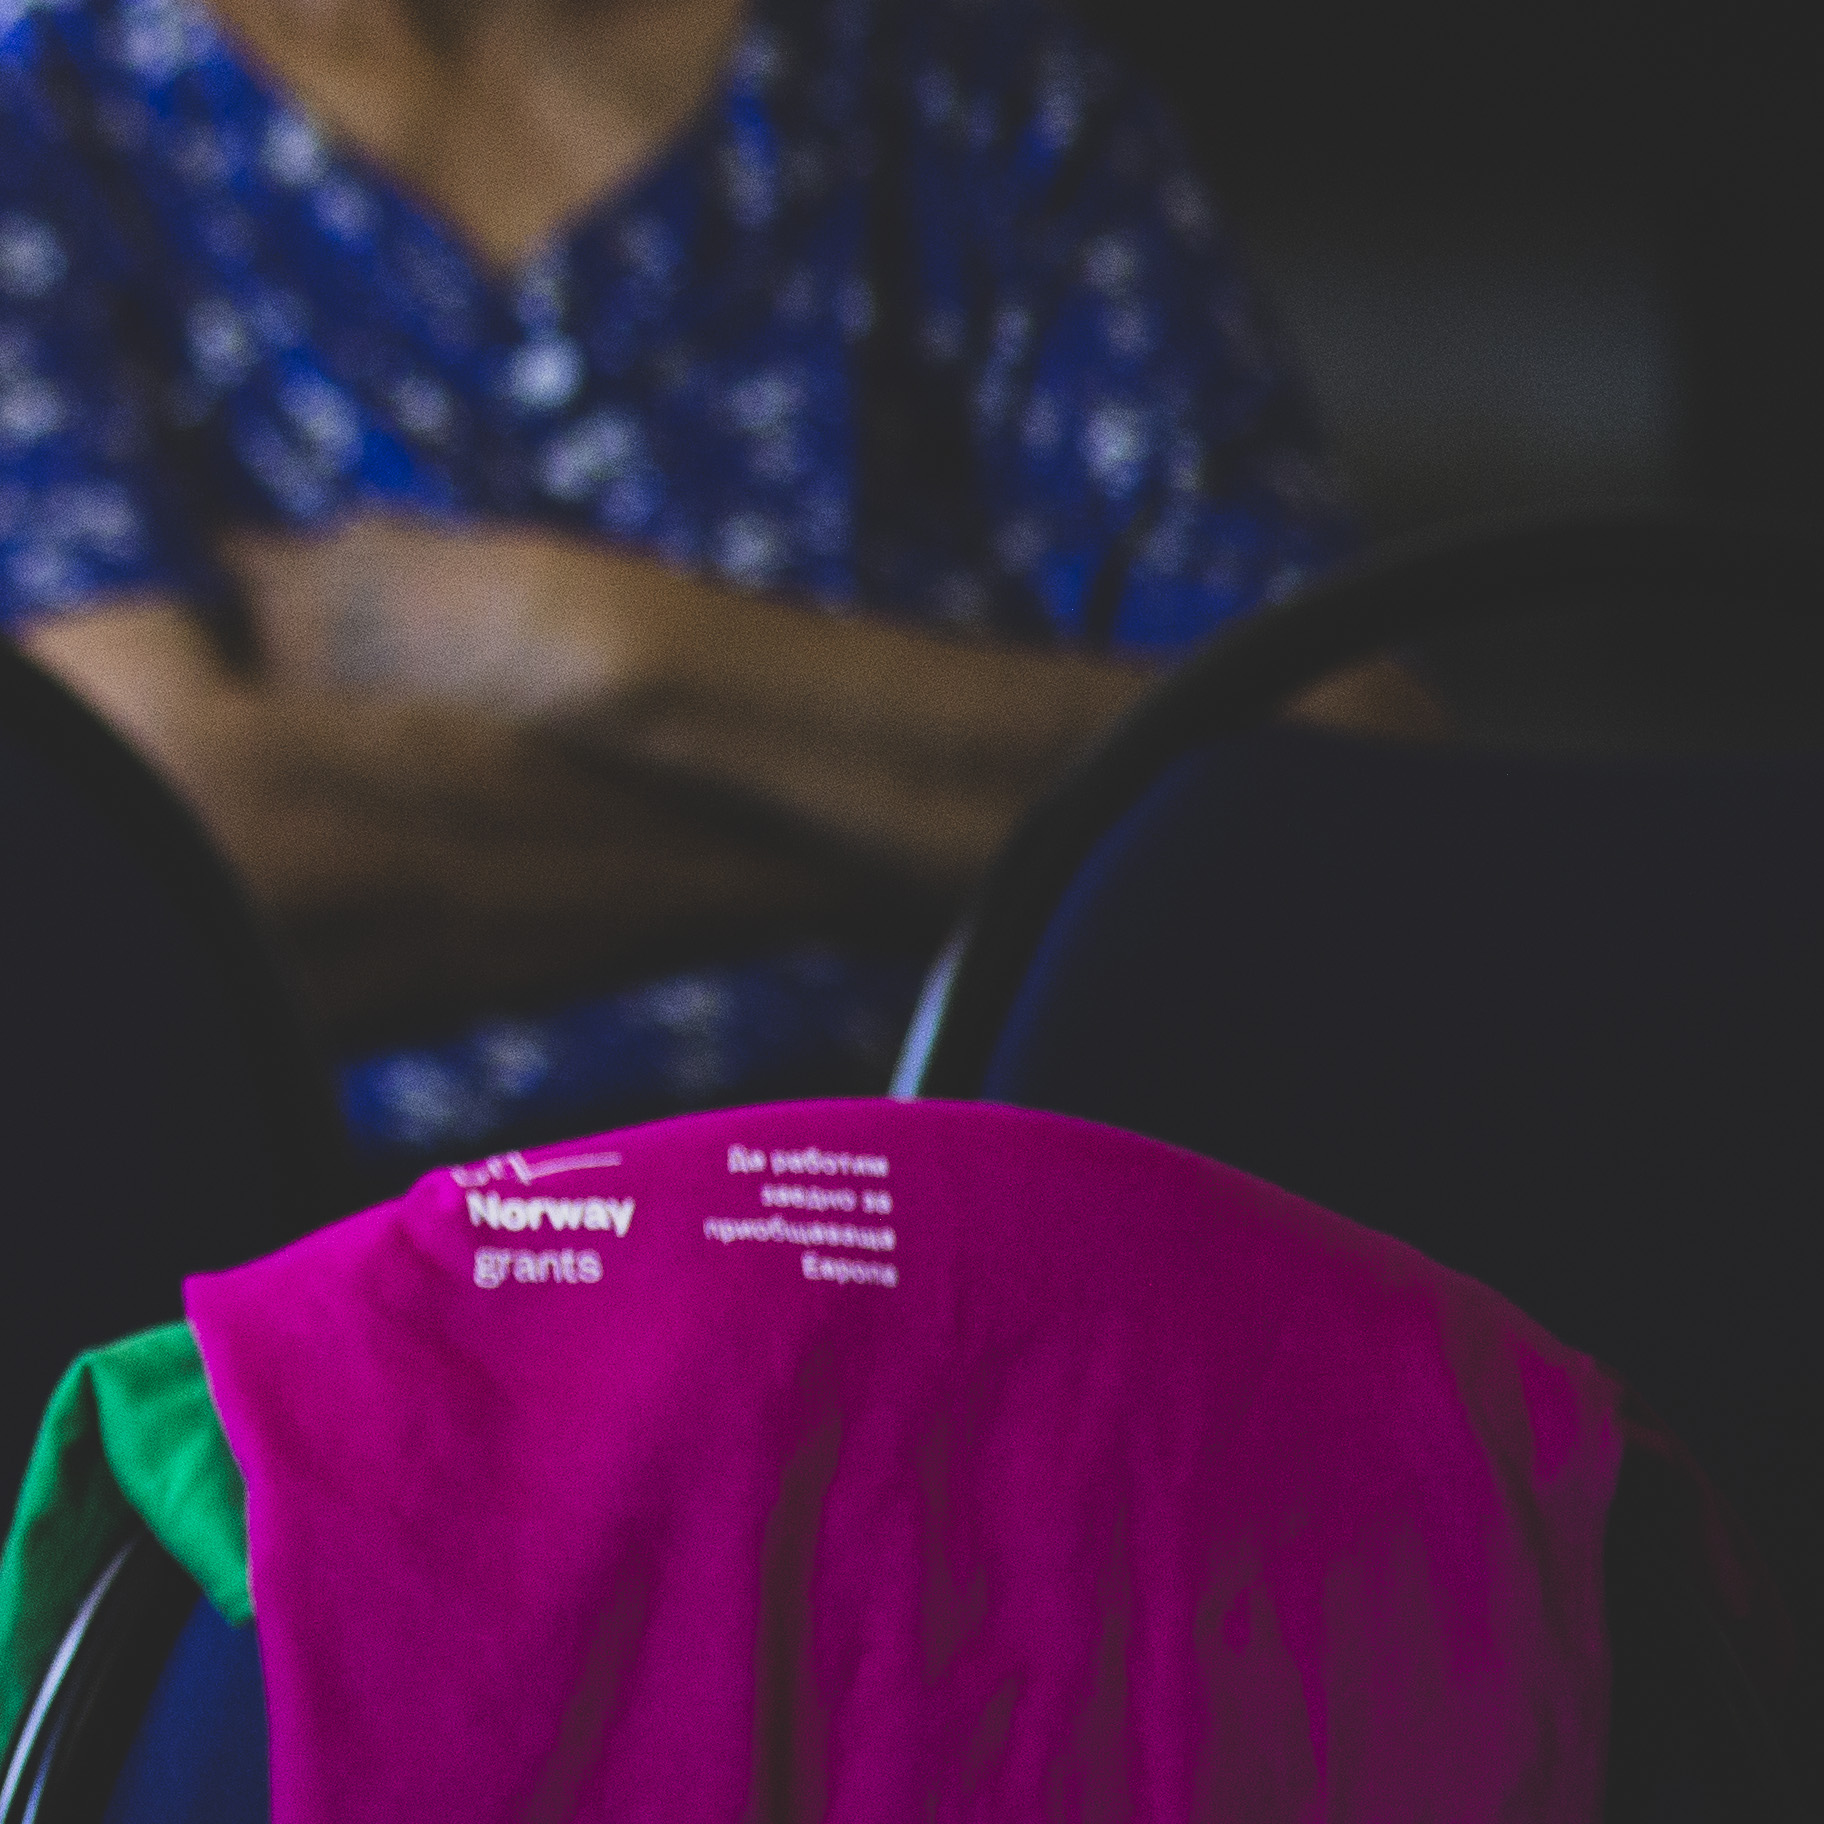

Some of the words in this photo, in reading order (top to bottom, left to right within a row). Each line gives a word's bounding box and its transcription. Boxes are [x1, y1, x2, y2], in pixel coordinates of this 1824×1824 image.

[728, 1144, 766, 1174] Да
[465, 1189, 635, 1238] Norway
[862, 1189, 892, 1214] за
[473, 1246, 603, 1289] grants
[801, 1251, 898, 1288] Европа
